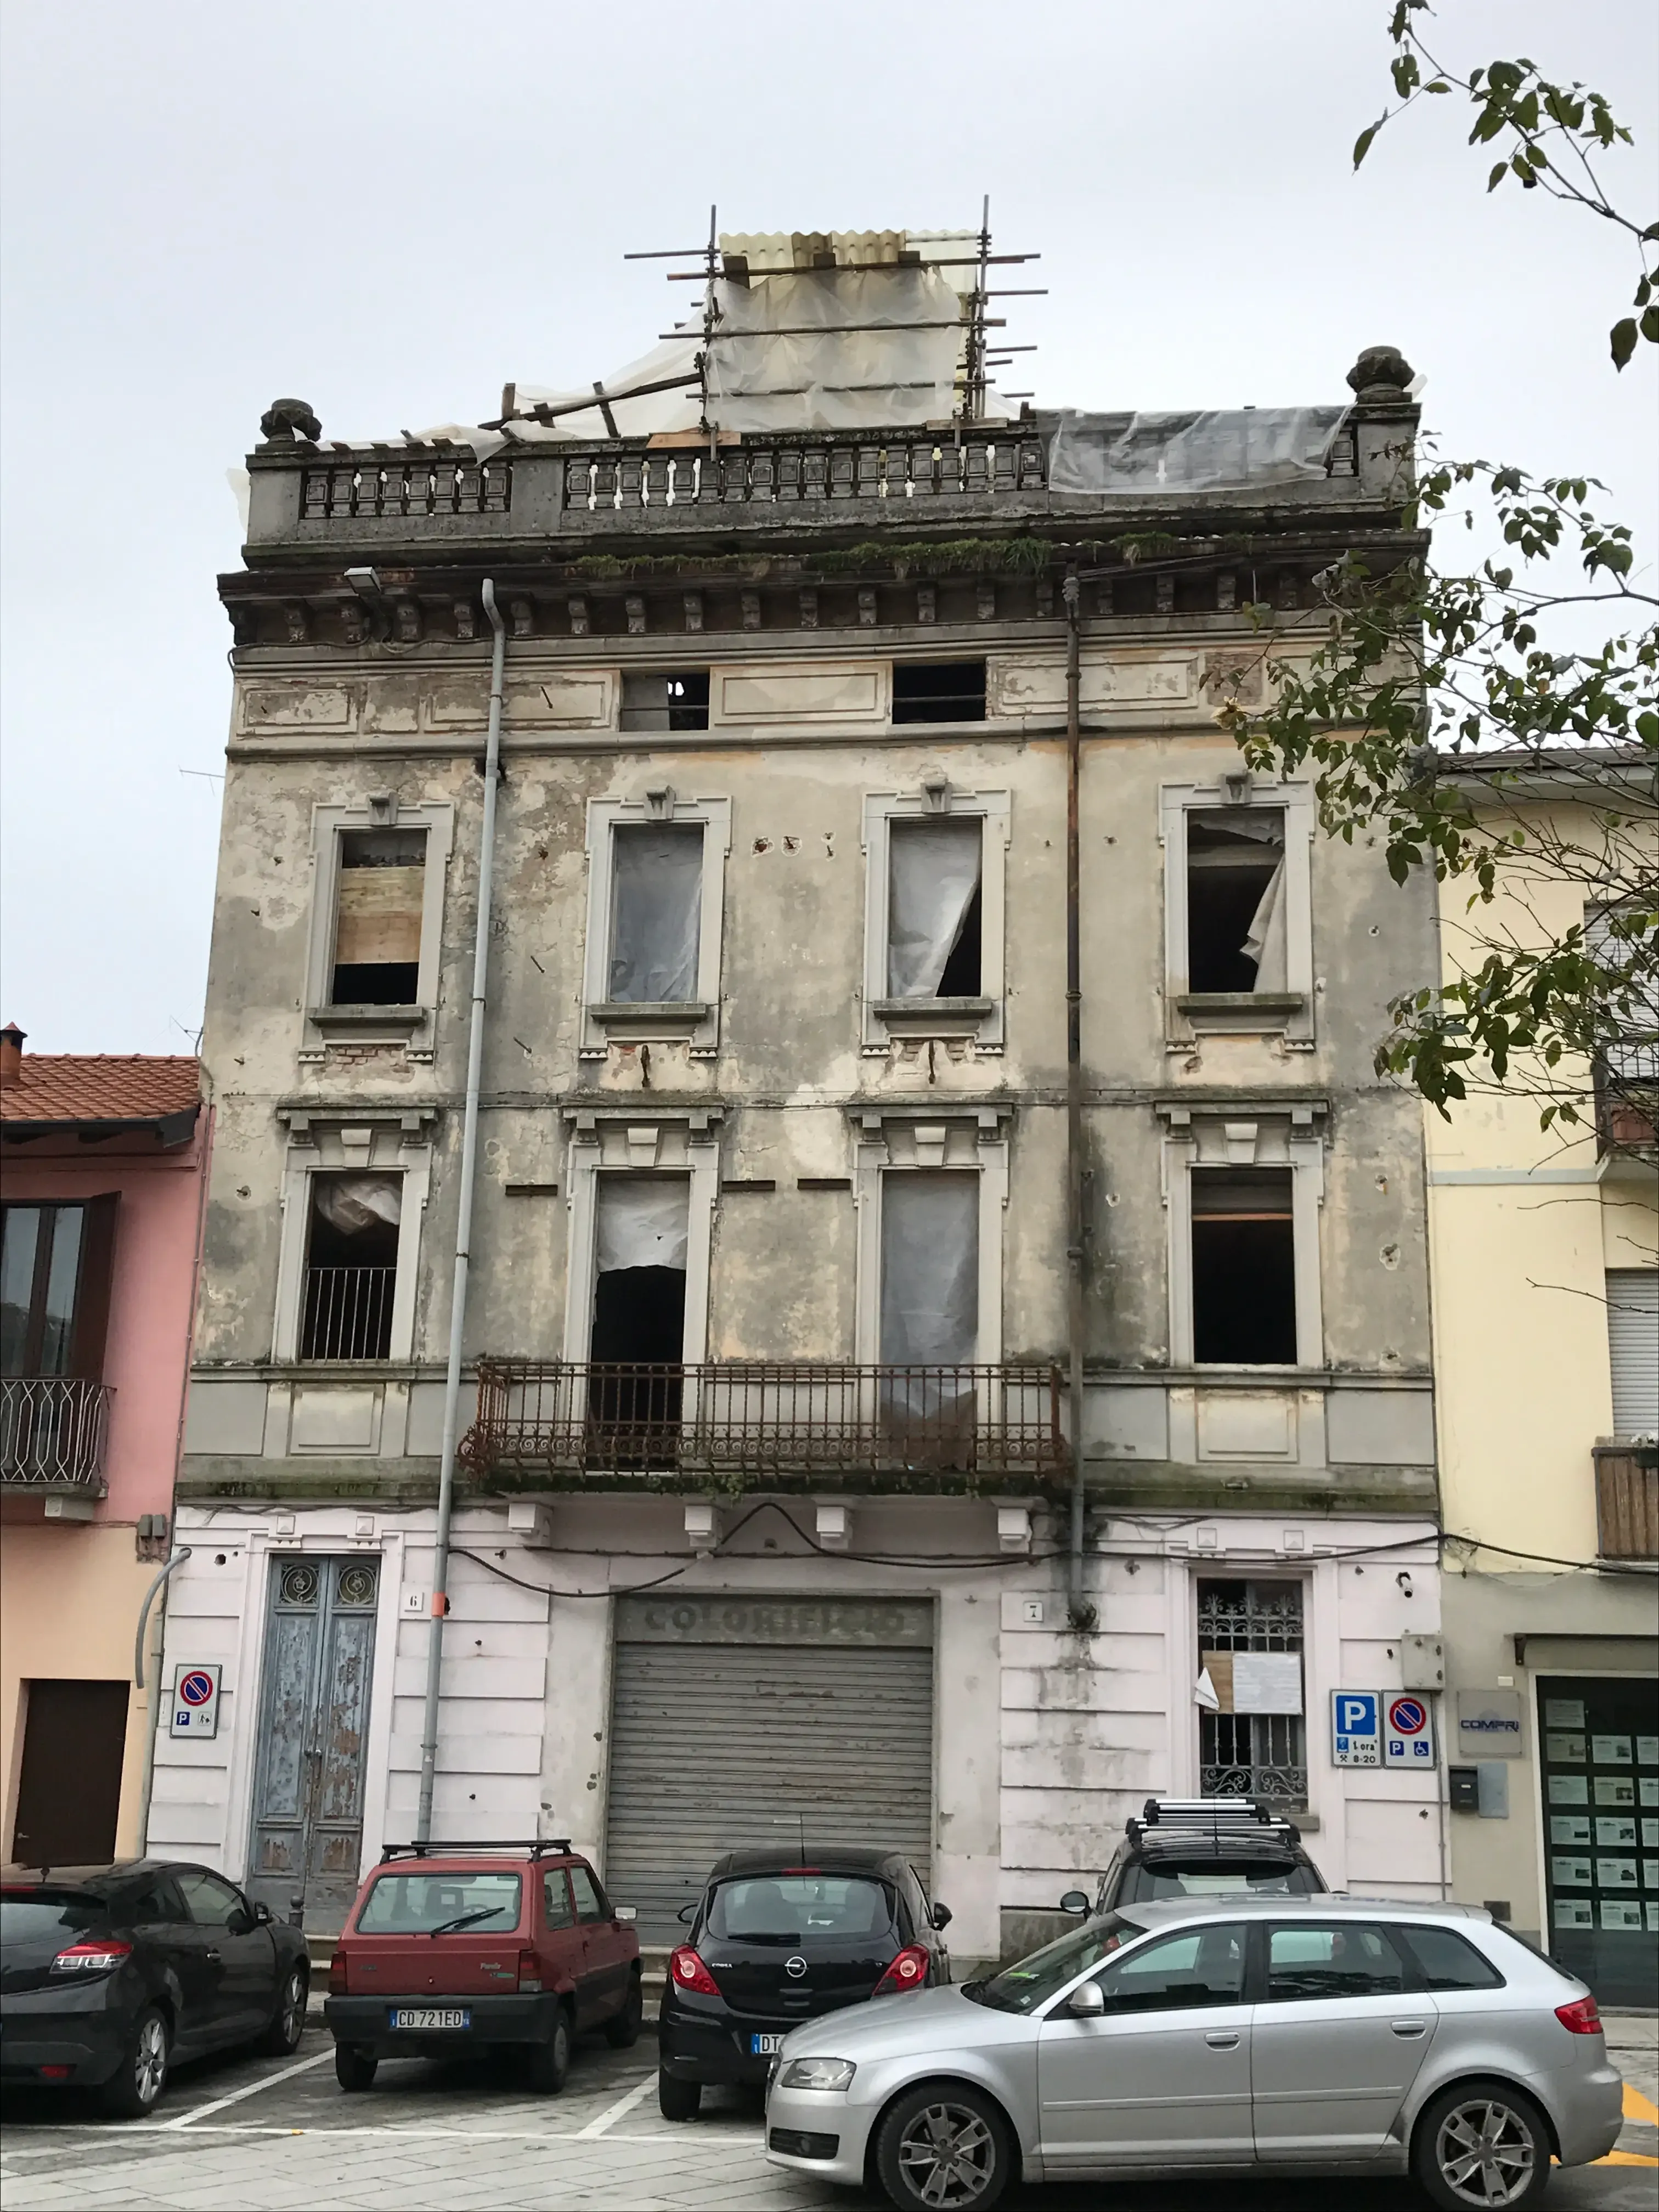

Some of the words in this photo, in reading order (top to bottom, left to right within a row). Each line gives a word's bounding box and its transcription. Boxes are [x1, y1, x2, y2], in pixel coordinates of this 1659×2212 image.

[410, 1596, 417, 1606] 6
[1030, 1605, 1036, 1618] 7
[178, 1713, 187, 1724] P
[1345, 1701, 1366, 1730] P
[1392, 1742, 1401, 1754] P
[762, 2036, 779, 2052] DT
